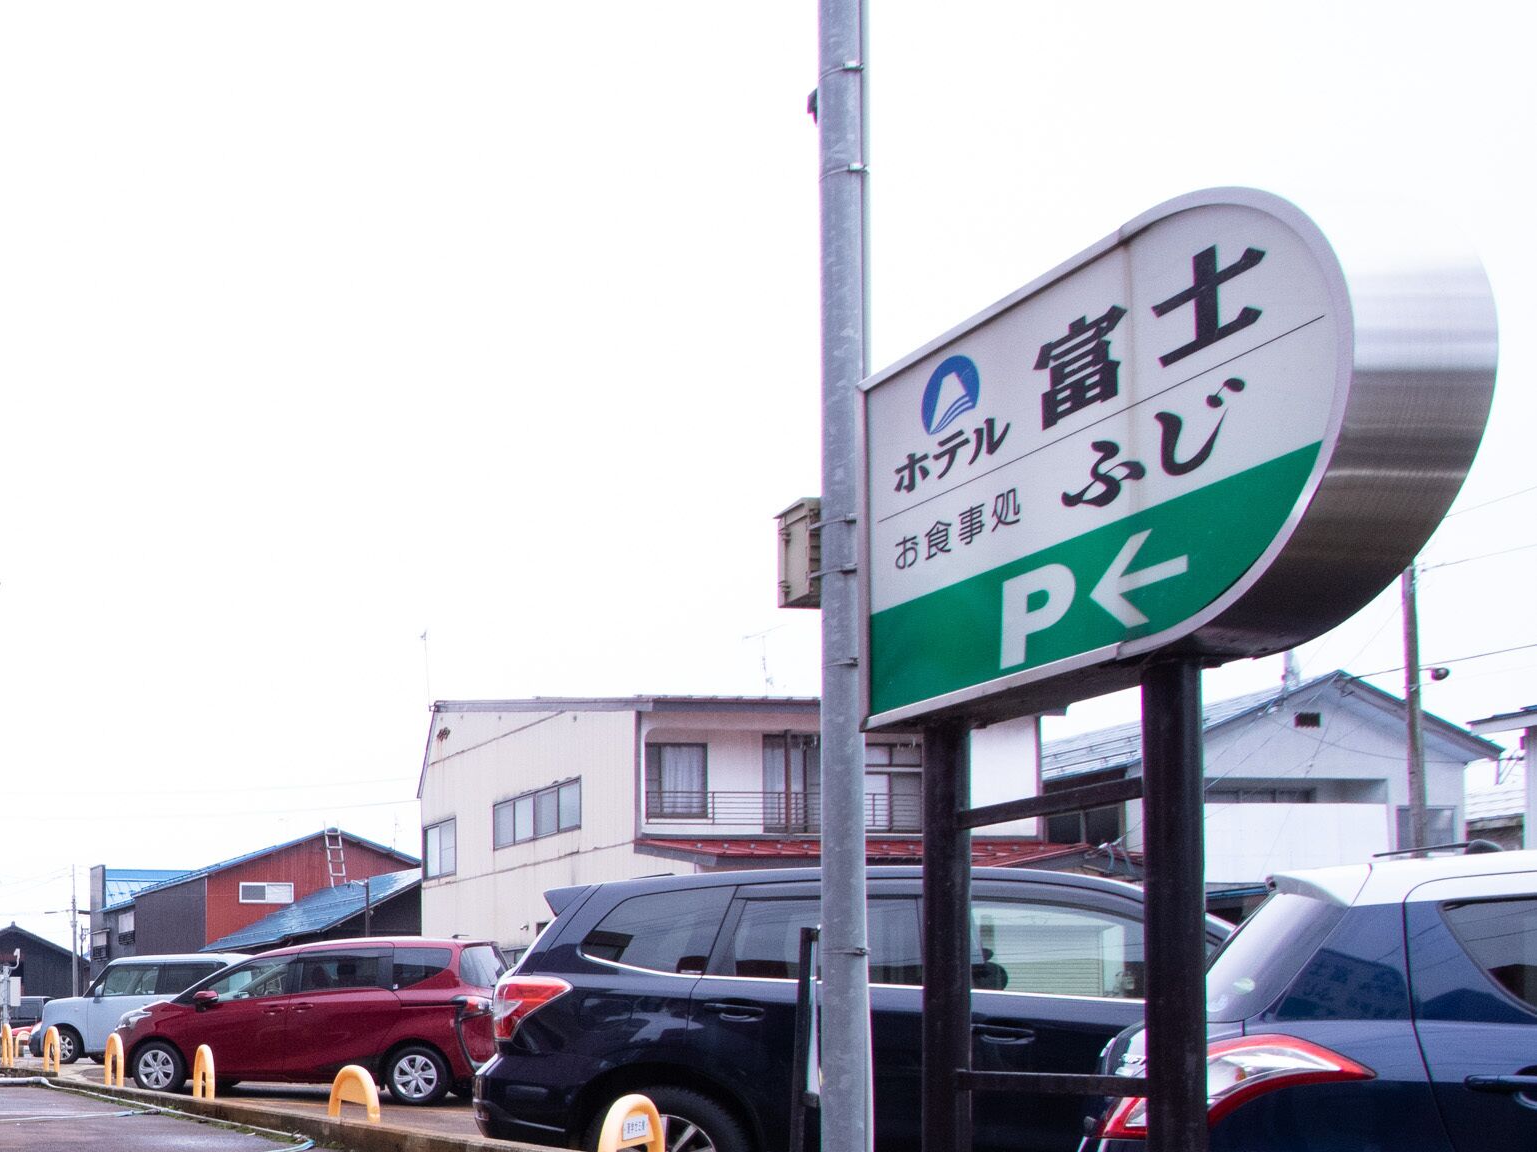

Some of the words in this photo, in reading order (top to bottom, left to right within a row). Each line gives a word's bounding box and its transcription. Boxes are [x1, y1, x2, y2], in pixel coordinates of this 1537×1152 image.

[1034, 244, 1266, 431] 富士
[894, 417, 1010, 493] ホテル
[1061, 377, 1245, 508] ふじ
[895, 488, 1020, 570] お食事処
[1000, 563, 1077, 670] P
